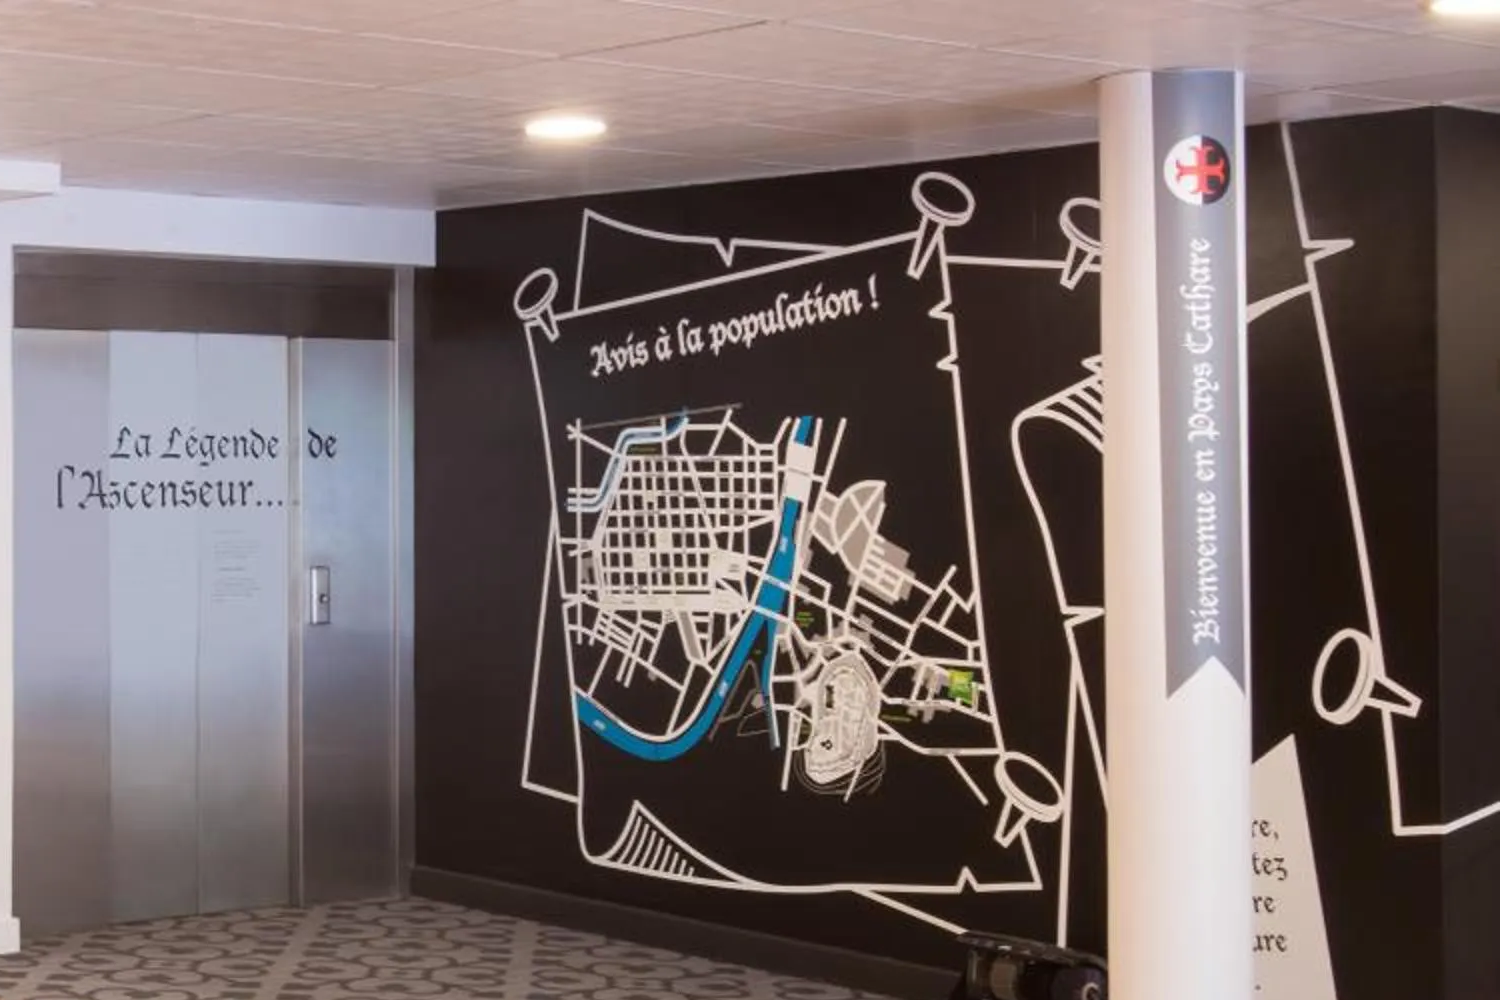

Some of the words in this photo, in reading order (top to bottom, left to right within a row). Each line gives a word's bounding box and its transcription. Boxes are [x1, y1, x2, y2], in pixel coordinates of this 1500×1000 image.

[589, 331, 649, 378] Avis
[654, 327, 672, 361] à
[677, 317, 705, 356] la
[708, 282, 862, 356] population
[1179, 237, 1216, 354] Cathare
[109, 425, 151, 460] La
[159, 425, 279, 466] Légende
[306, 427, 338, 459] de
[1187, 361, 1220, 443] Pays
[1194, 447, 1217, 482] en
[1190, 489, 1220, 645] Bienvenue
